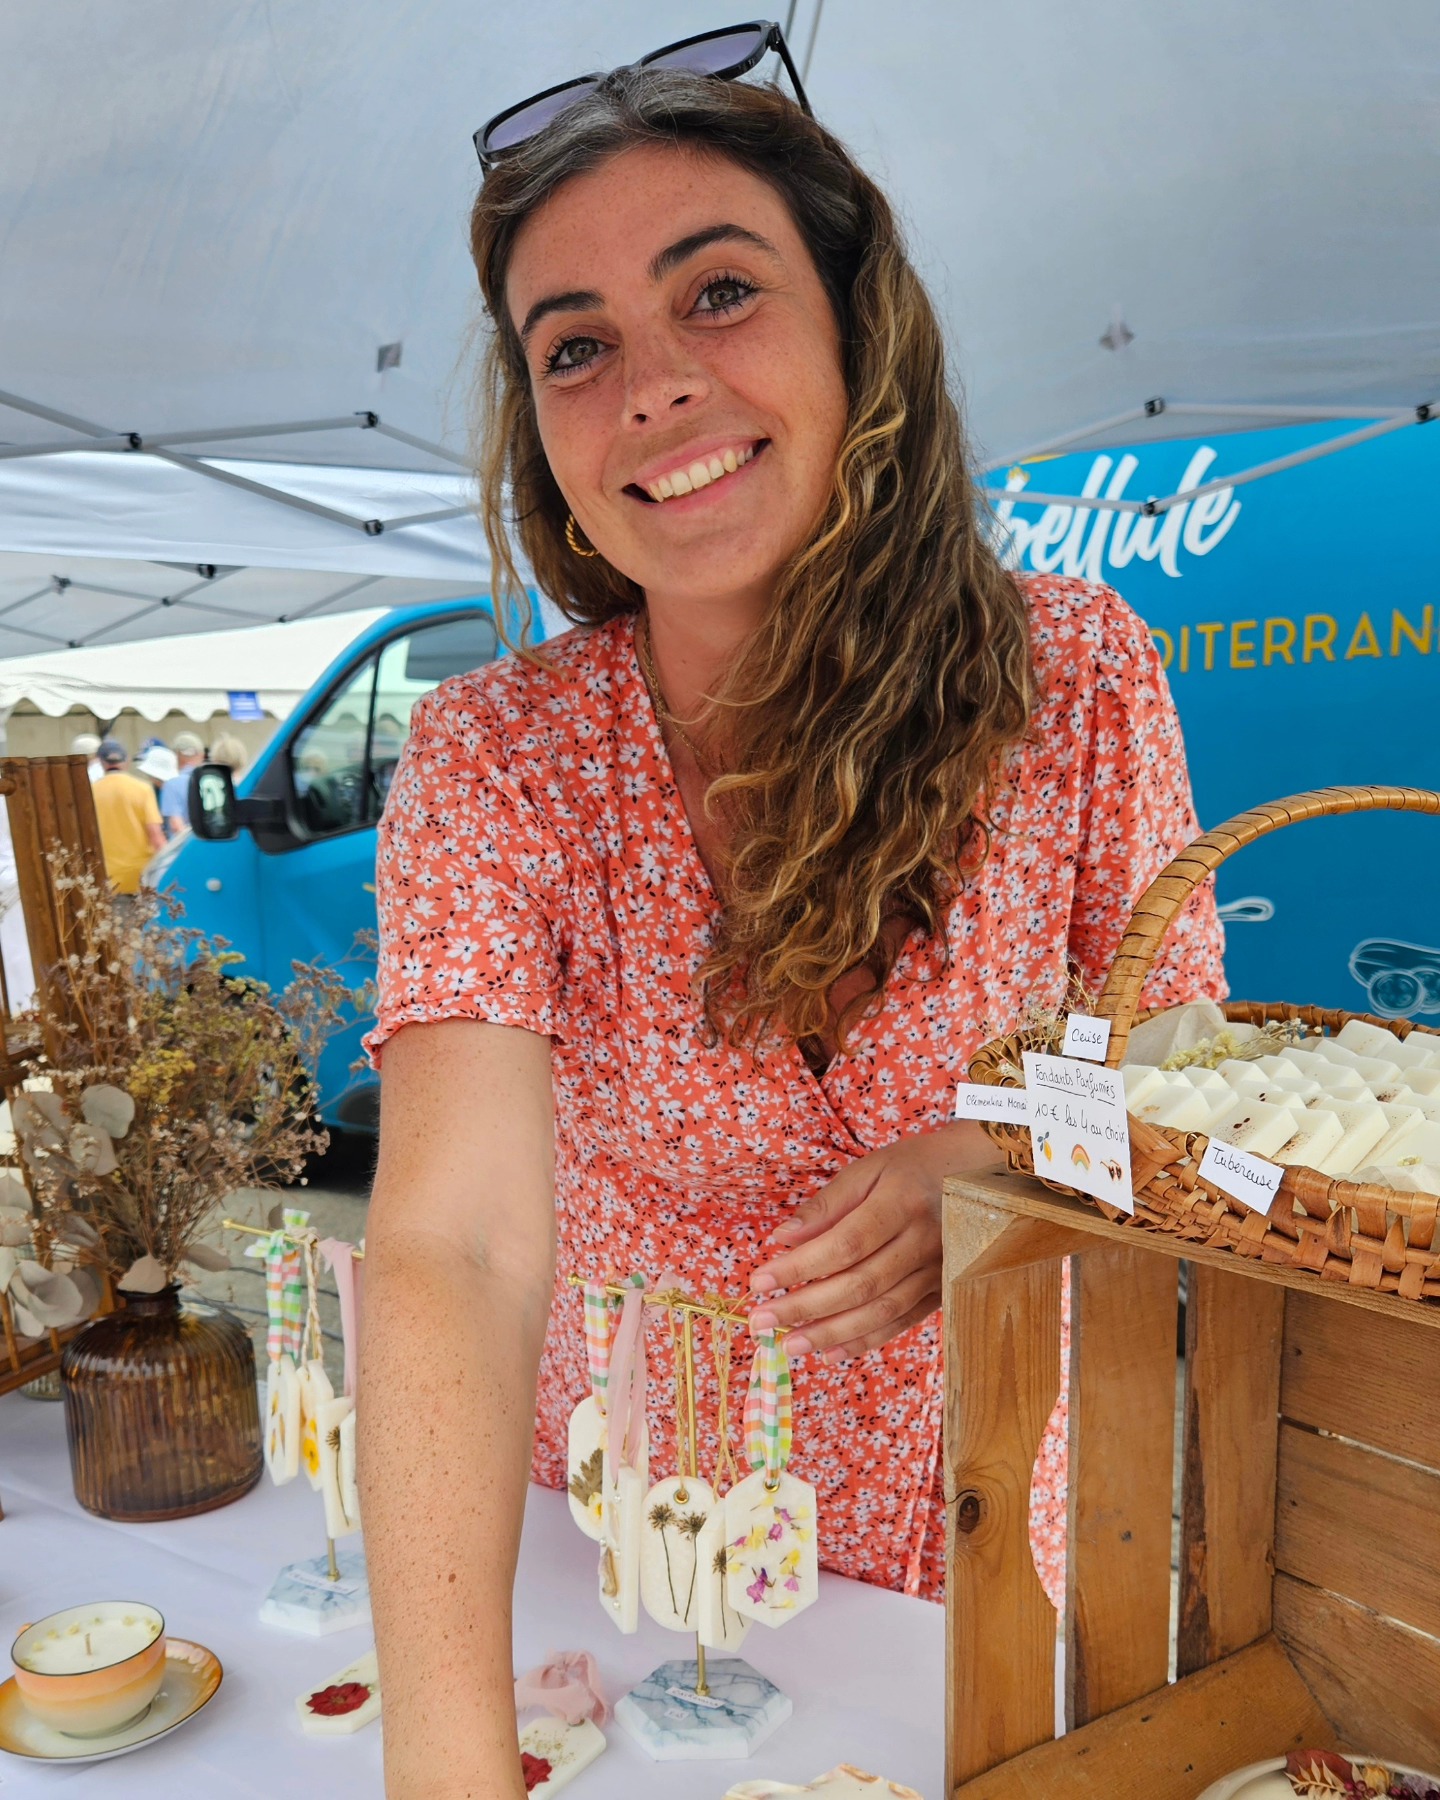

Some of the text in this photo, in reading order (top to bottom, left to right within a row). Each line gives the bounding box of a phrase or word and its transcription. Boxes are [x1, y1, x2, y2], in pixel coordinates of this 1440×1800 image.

[978, 444, 1242, 583] bellule
[1150, 603, 1440, 674] DITERRAN
[1035, 1063, 1116, 1099] Fondants Parfumés
[1065, 1104, 1078, 1128] les
[1080, 1109, 1088, 1133] 4
[1090, 1124, 1103, 1136] au
[1105, 1119, 1126, 1143] choix
[1212, 1145, 1275, 1191] Tubéreuse
